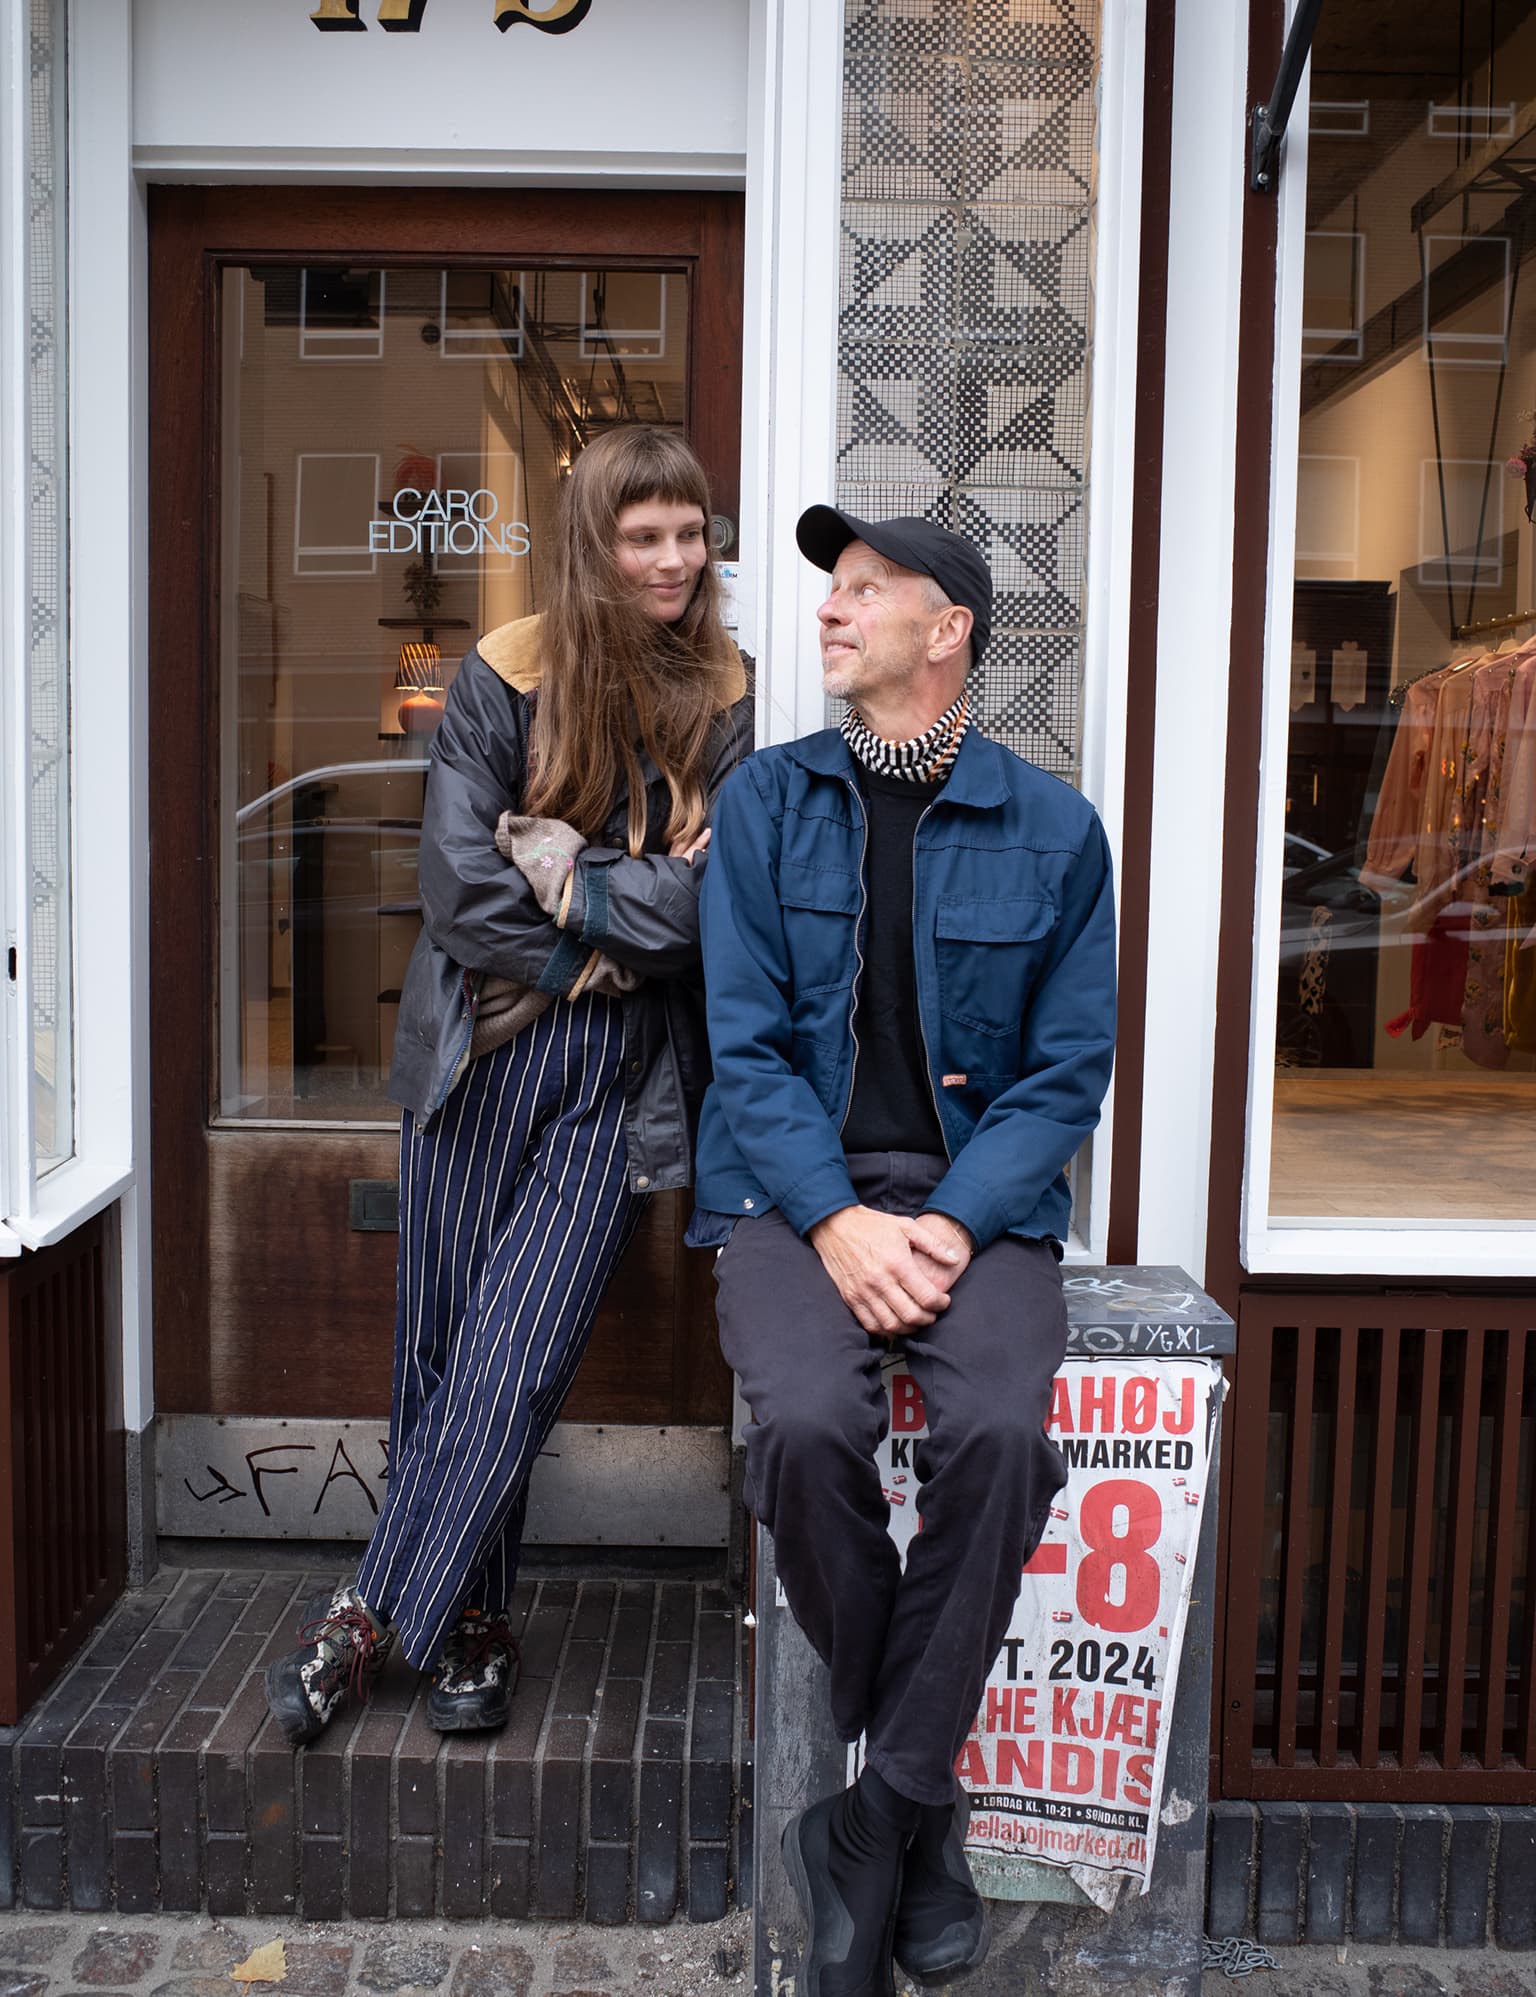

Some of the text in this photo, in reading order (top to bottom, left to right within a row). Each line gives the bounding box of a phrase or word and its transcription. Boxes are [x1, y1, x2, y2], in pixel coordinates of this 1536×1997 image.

[392, 487, 499, 524] CARO
[368, 520, 532, 556] EDITIONS
[1048, 1638, 1157, 1691] 2024
[953, 1738, 1155, 1807] ANDIS
[982, 1795, 1145, 1829] LØRDAG KL. 10-21 SØNDAG KL.
